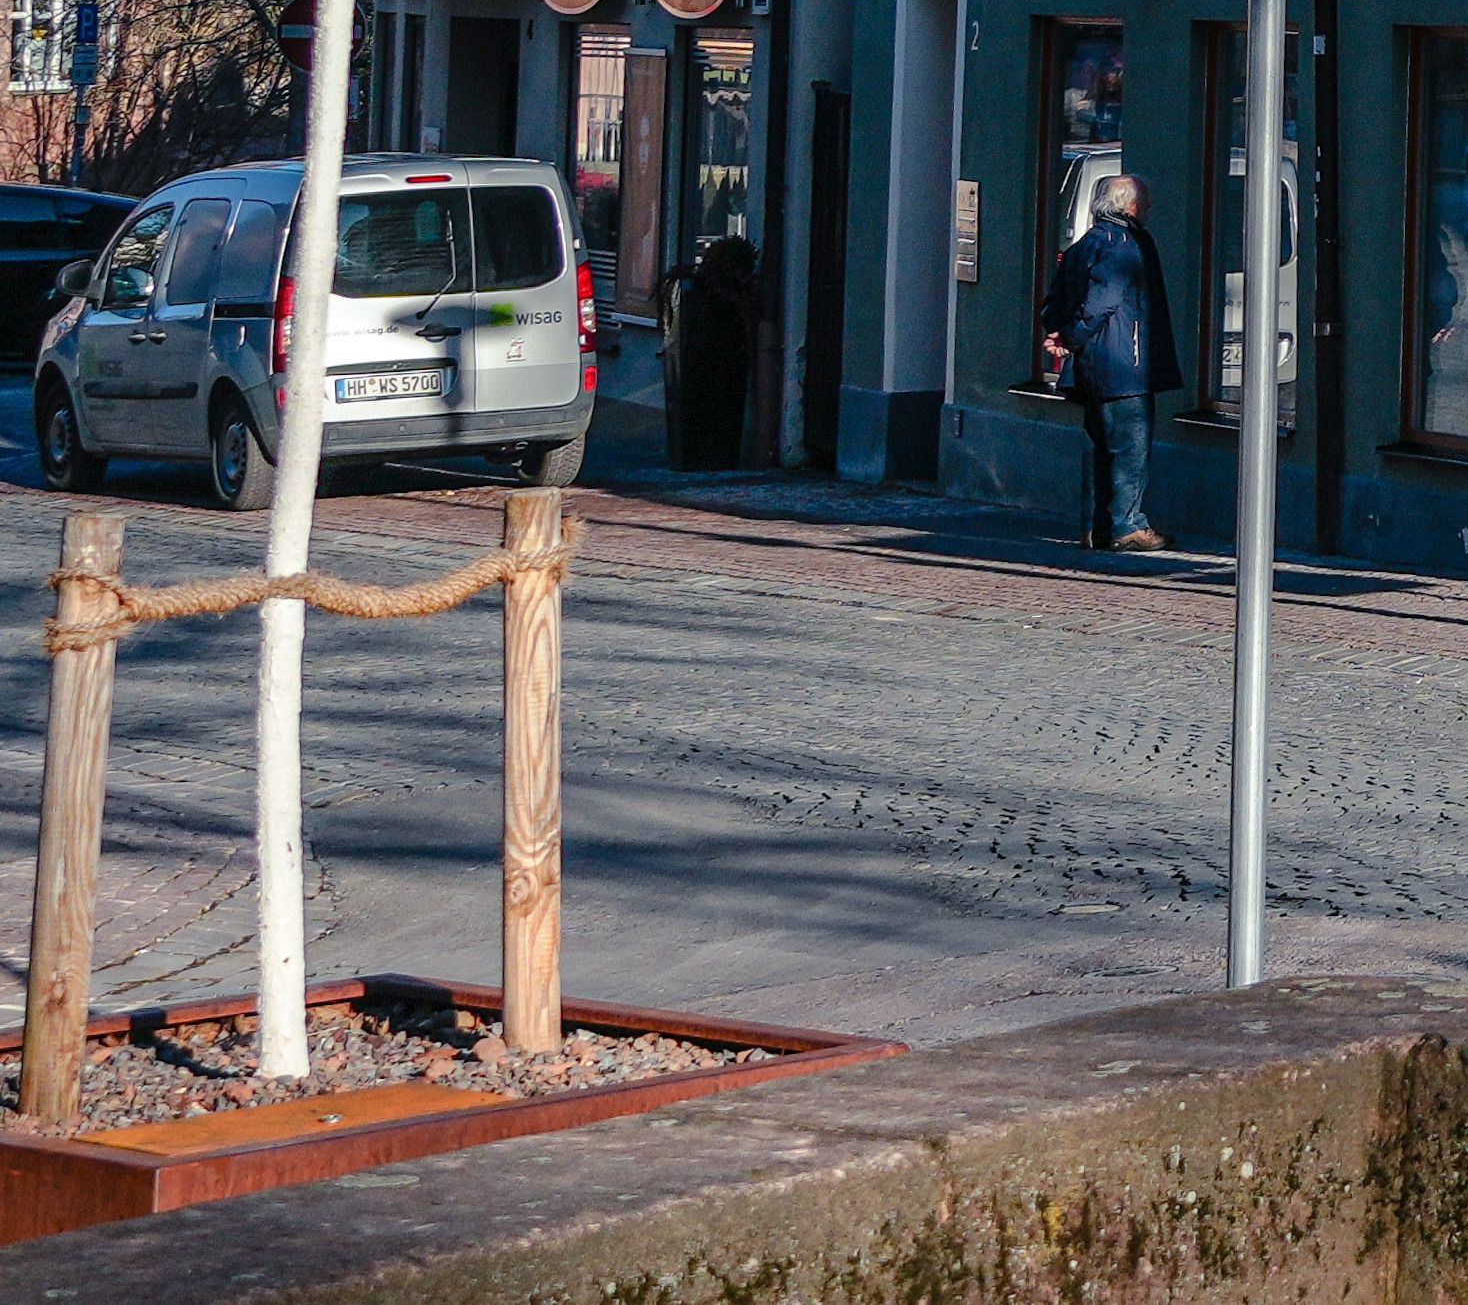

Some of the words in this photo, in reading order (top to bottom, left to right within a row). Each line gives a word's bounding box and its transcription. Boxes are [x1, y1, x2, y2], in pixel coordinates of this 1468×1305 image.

[971, 21, 979, 50] 2
[347, 379, 367, 396] HH
[379, 377, 398, 393] WS
[402, 374, 440, 392] 5700
